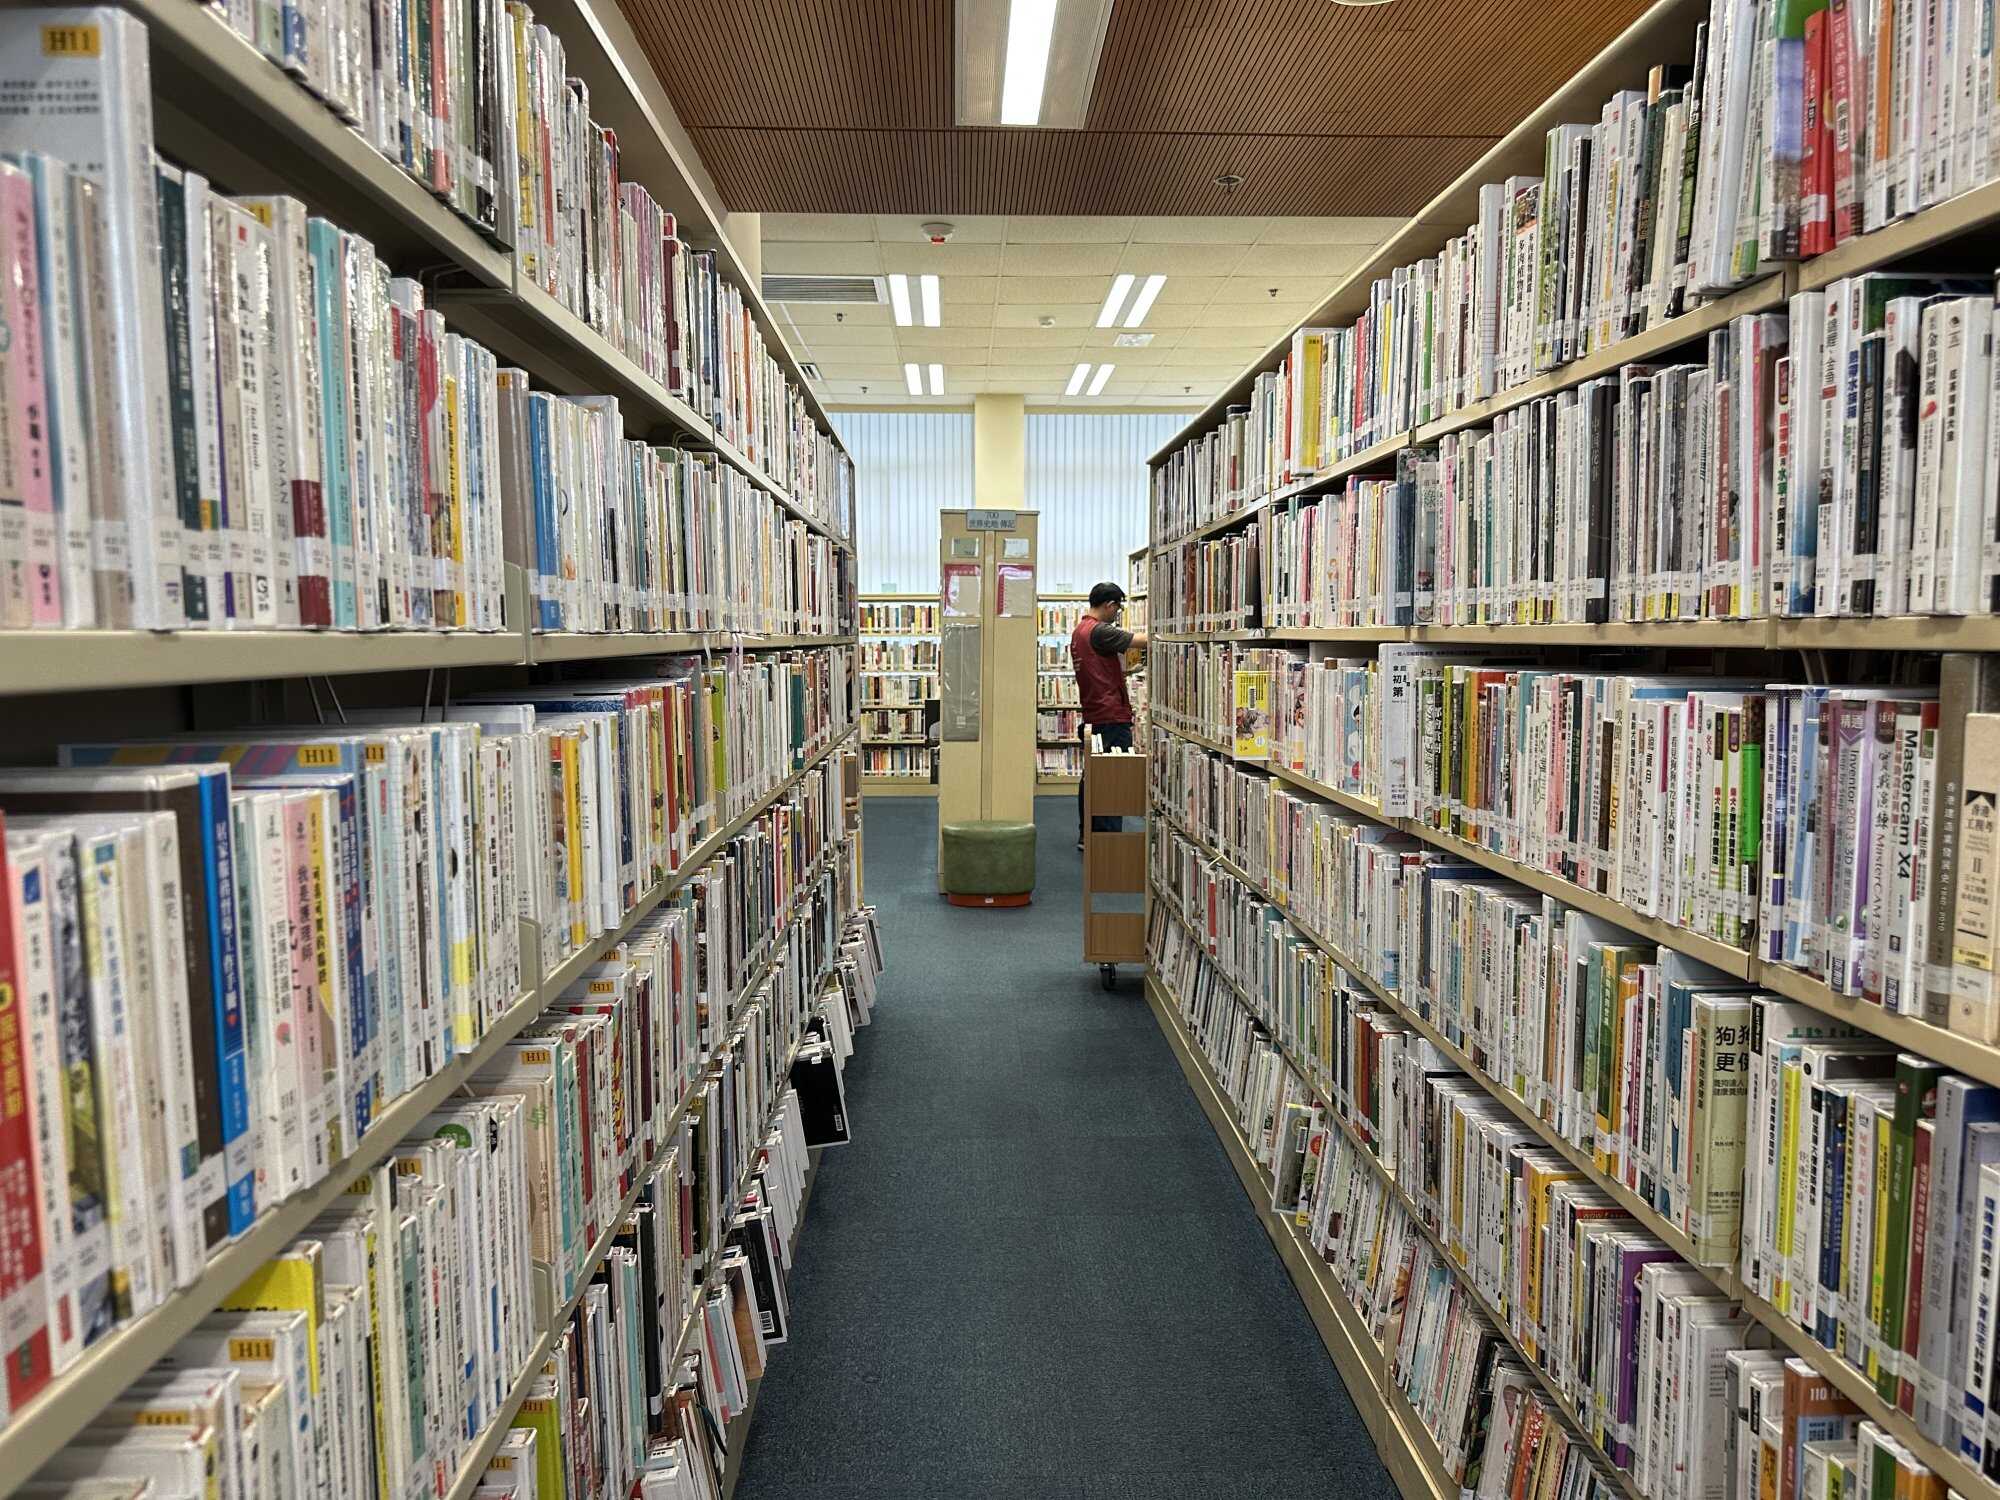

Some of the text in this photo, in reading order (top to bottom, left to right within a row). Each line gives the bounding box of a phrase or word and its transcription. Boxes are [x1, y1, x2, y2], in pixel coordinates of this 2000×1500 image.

[50, 30, 90, 51] H11
[985, 511, 999, 519] 700
[304, 749, 334, 763] H11
[1848, 750, 1860, 807] Inventor
[1899, 729, 1919, 849] Mastercam
[1608, 797, 1619, 831] Dog
[1897, 855, 1911, 880] X4
[593, 982, 611, 991] H11
[526, 1052, 546, 1062] H11
[239, 1343, 271, 1358] H11
